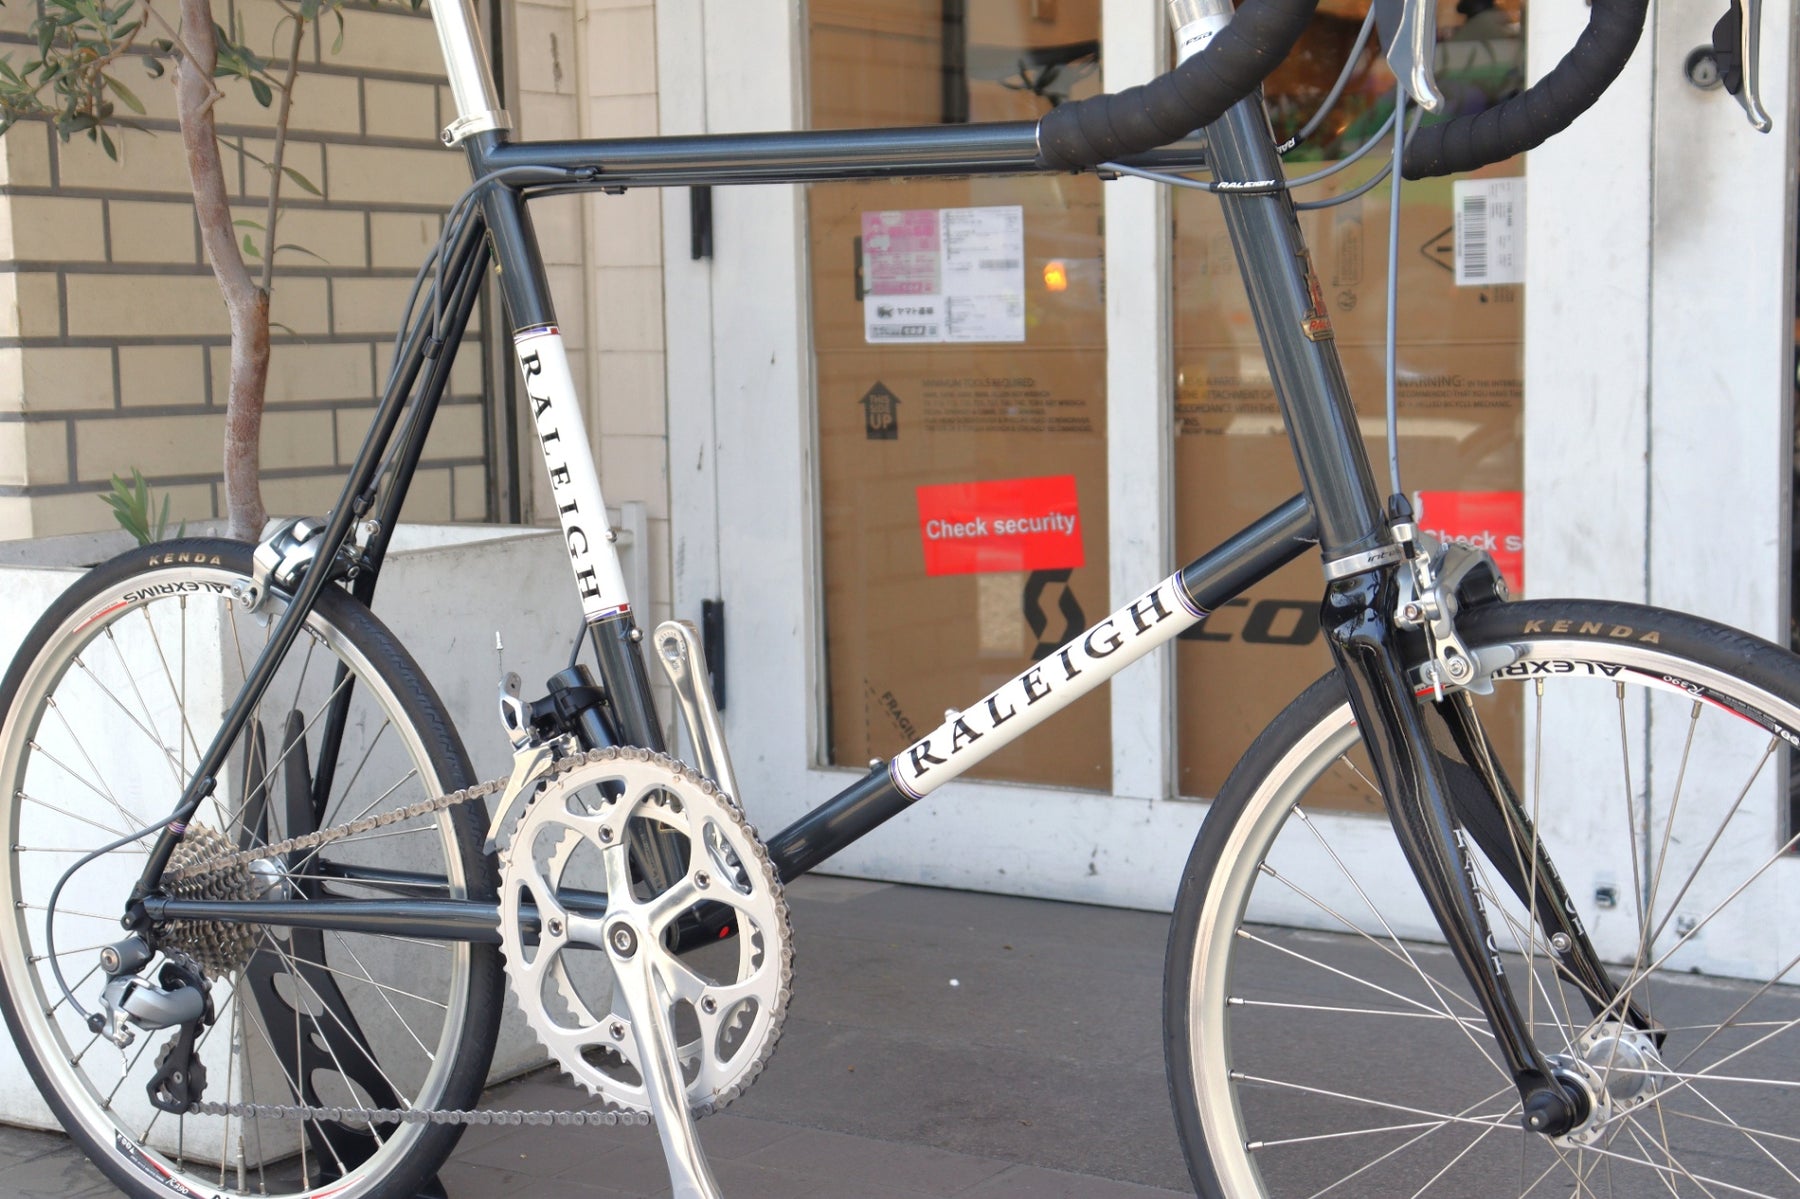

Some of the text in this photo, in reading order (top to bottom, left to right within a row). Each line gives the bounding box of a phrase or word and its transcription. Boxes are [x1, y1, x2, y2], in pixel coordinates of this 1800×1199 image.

[1216, 179, 1276, 189] RALEIGH
[870, 413, 893, 430] UP
[519, 348, 603, 601] RALEIGH
[925, 511, 1077, 540] Check security
[148, 552, 222, 568] KENDA
[122, 579, 226, 605] ALEXRIMS
[1522, 618, 1663, 645] KENDA
[906, 585, 1173, 777] RALEIGH
[1662, 674, 1706, 698] R390
[164, 1175, 190, 1196] R390
